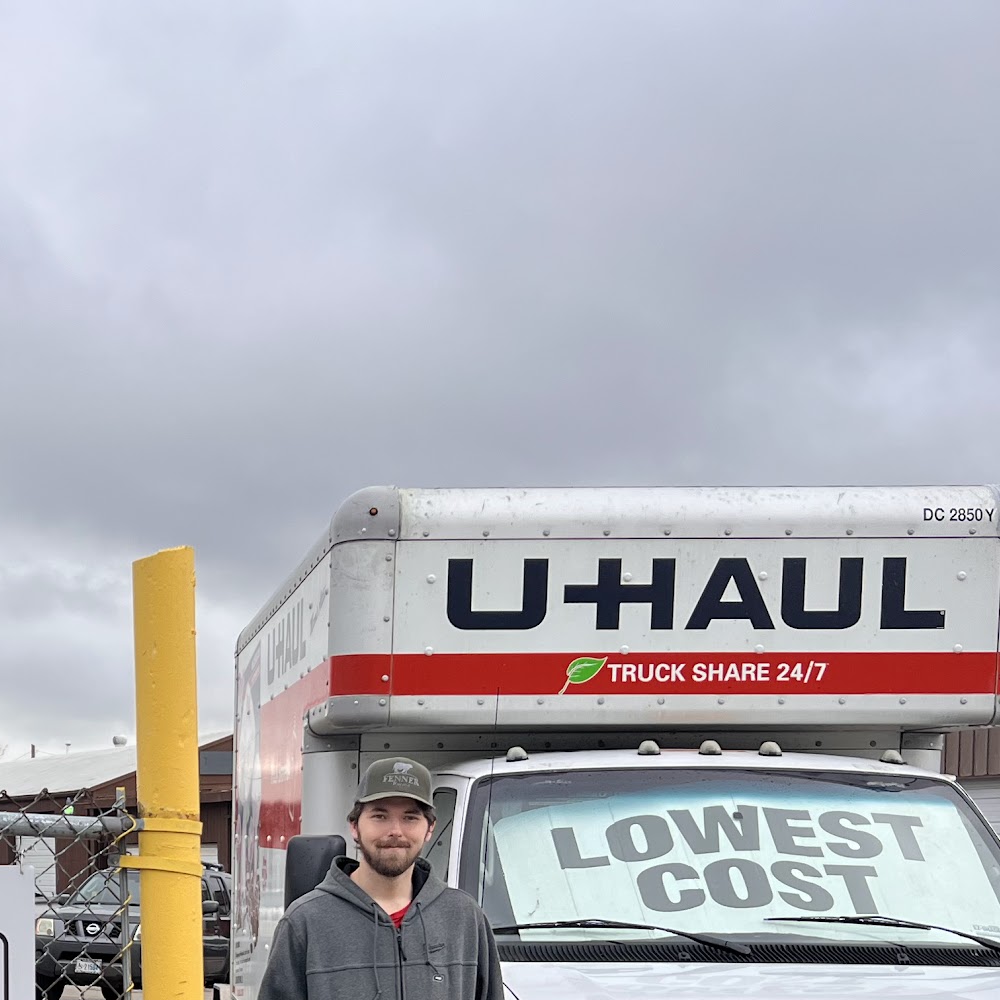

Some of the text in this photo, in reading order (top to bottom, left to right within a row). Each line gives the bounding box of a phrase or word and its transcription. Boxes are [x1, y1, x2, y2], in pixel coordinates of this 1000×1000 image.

[923, 507, 945, 521] DC
[446, 556, 946, 630] U-HAUL
[607, 661, 828, 684] TRUCK SHARE 24/7
[382, 775, 420, 787] FENNER
[551, 804, 926, 870] LOWEST
[636, 858, 879, 914] COST
